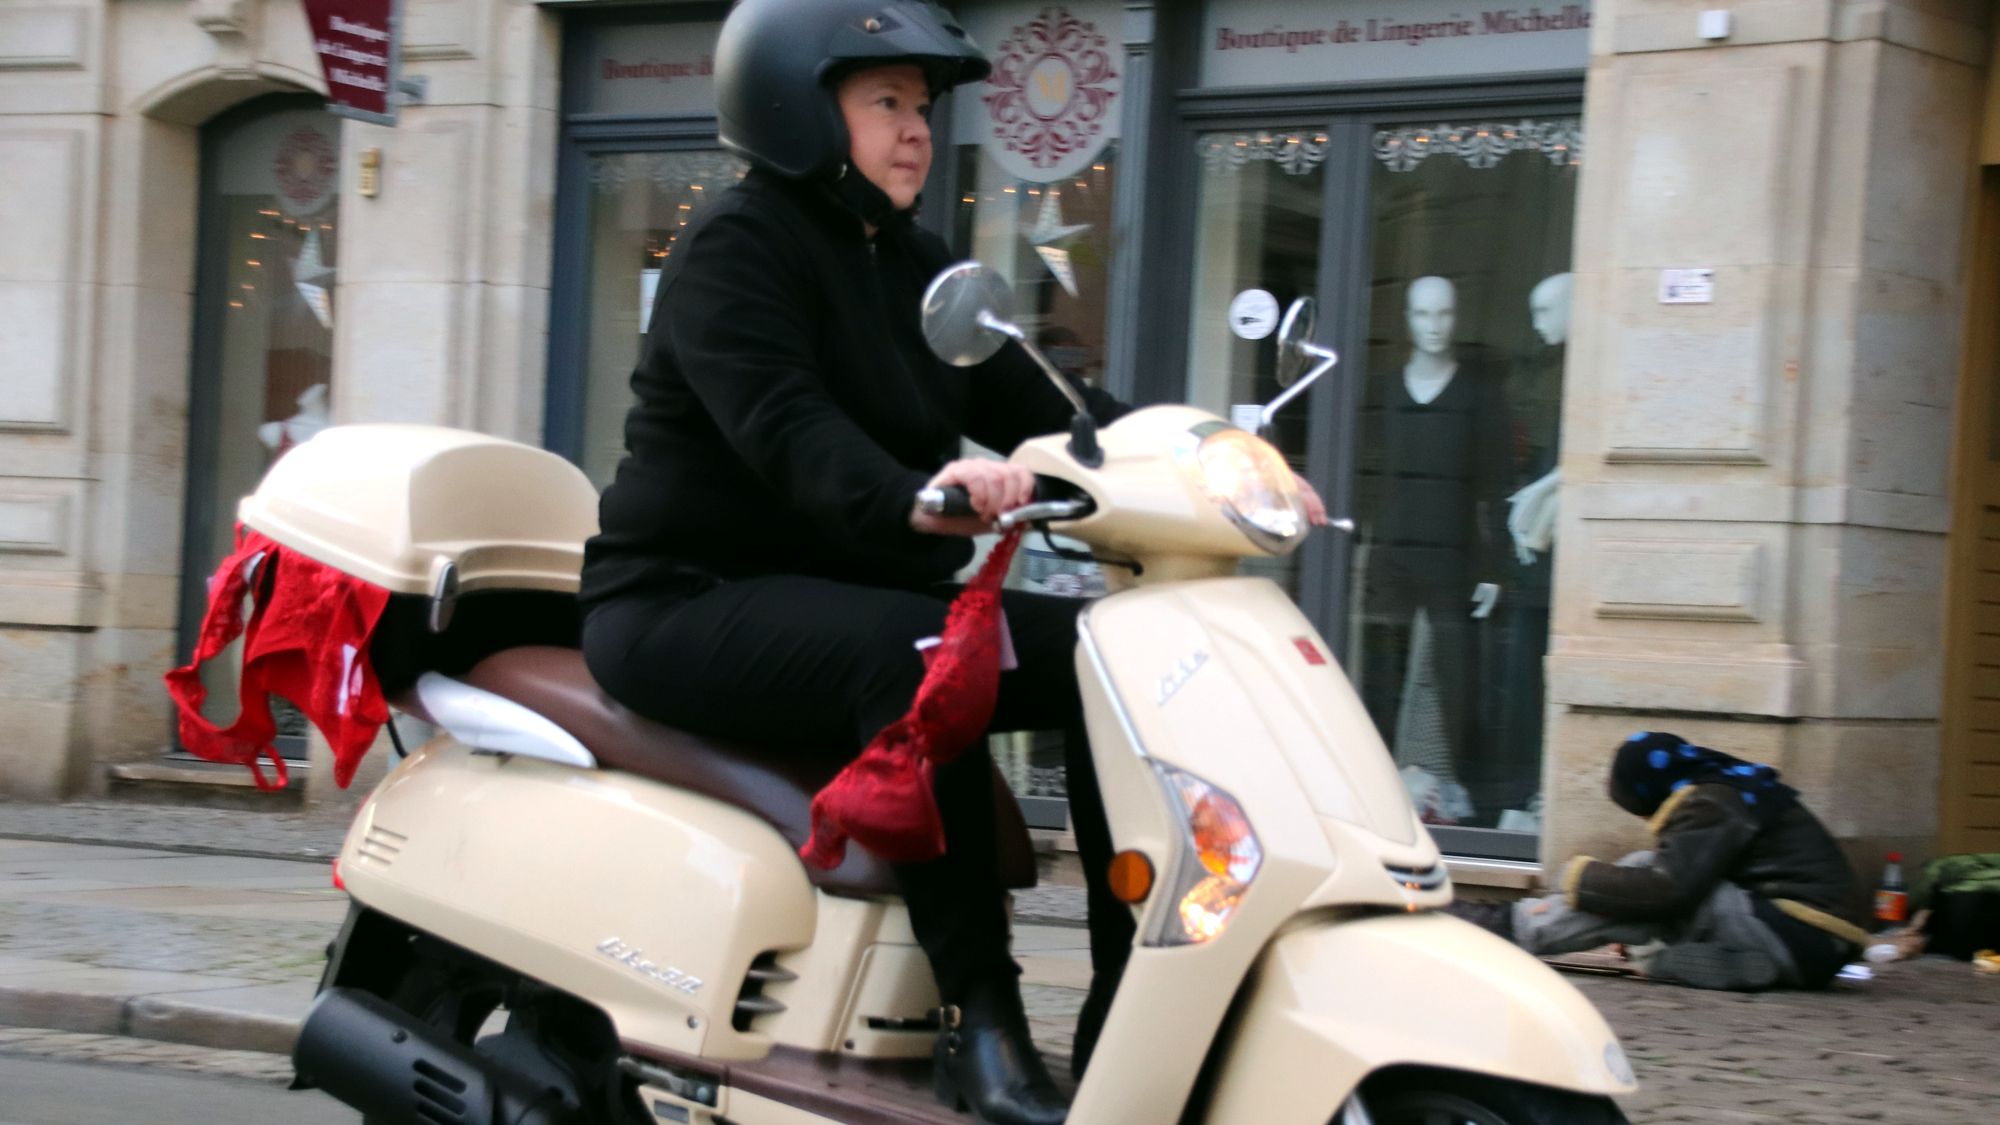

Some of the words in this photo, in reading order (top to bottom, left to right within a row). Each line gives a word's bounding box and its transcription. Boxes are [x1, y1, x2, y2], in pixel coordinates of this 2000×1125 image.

[1215, 25, 1324, 53] Boutique
[1330, 20, 1362, 44] de
[1365, 13, 1474, 46] Lingerie
[603, 57, 691, 83] Boutique
